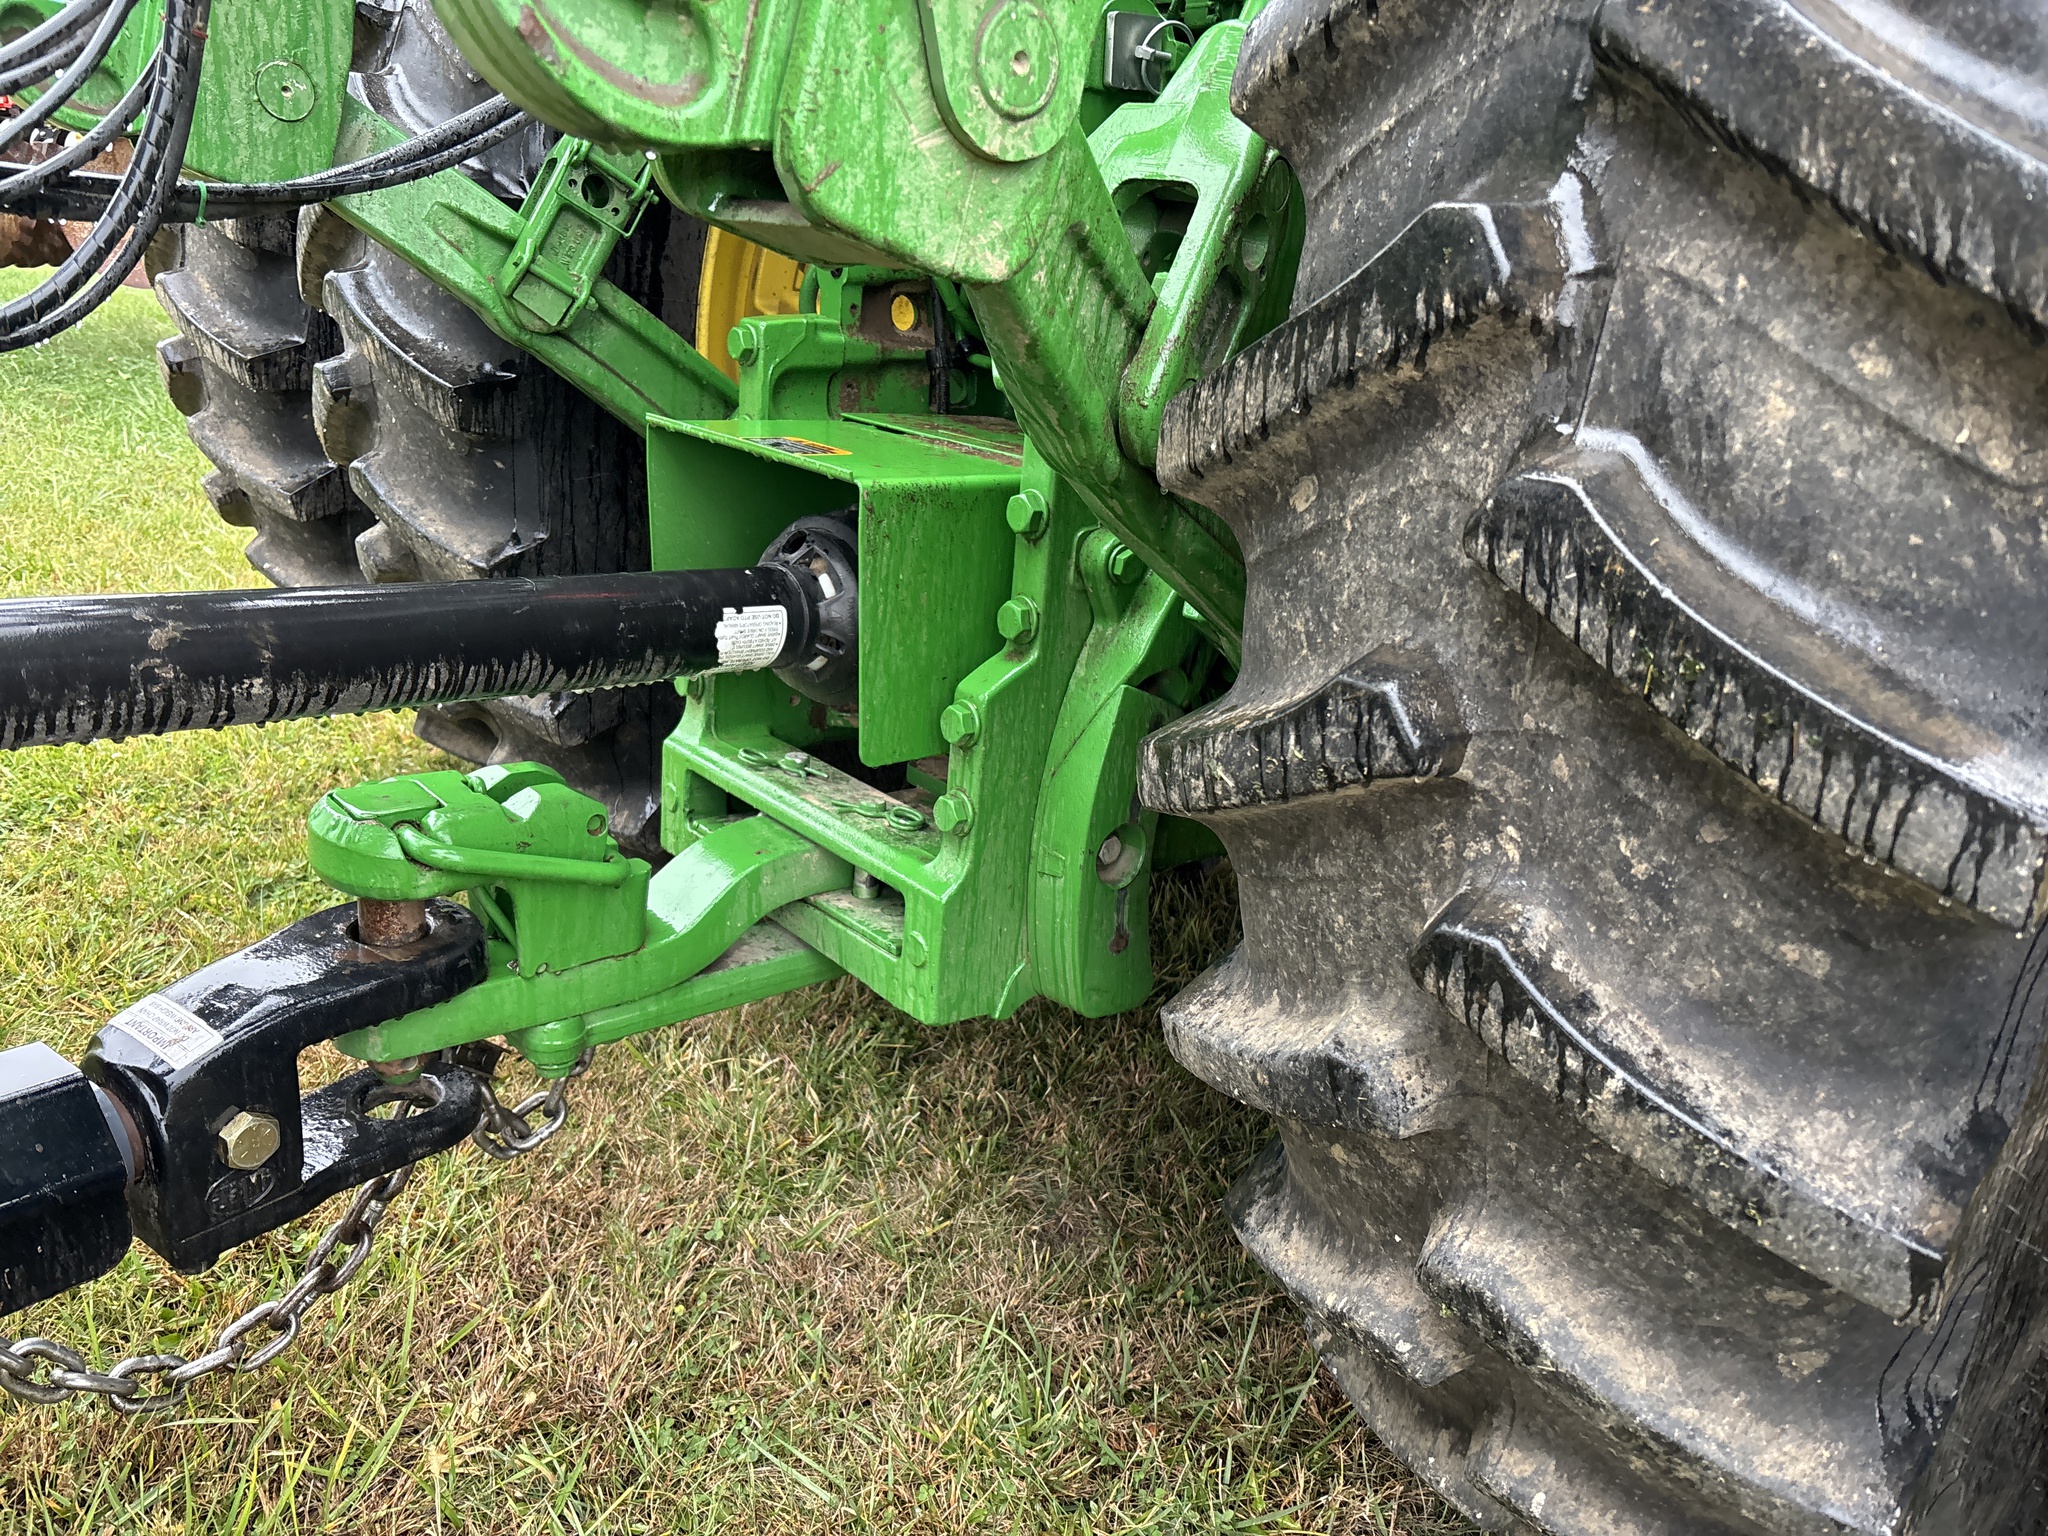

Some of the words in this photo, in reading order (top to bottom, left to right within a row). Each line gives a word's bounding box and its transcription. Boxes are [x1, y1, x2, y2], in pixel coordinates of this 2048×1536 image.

[152, 1017, 170, 1028] WRAP
[124, 1018, 172, 1050] IMPORTANT
[166, 1025, 182, 1036] NOT
[178, 1033, 190, 1042] DO
